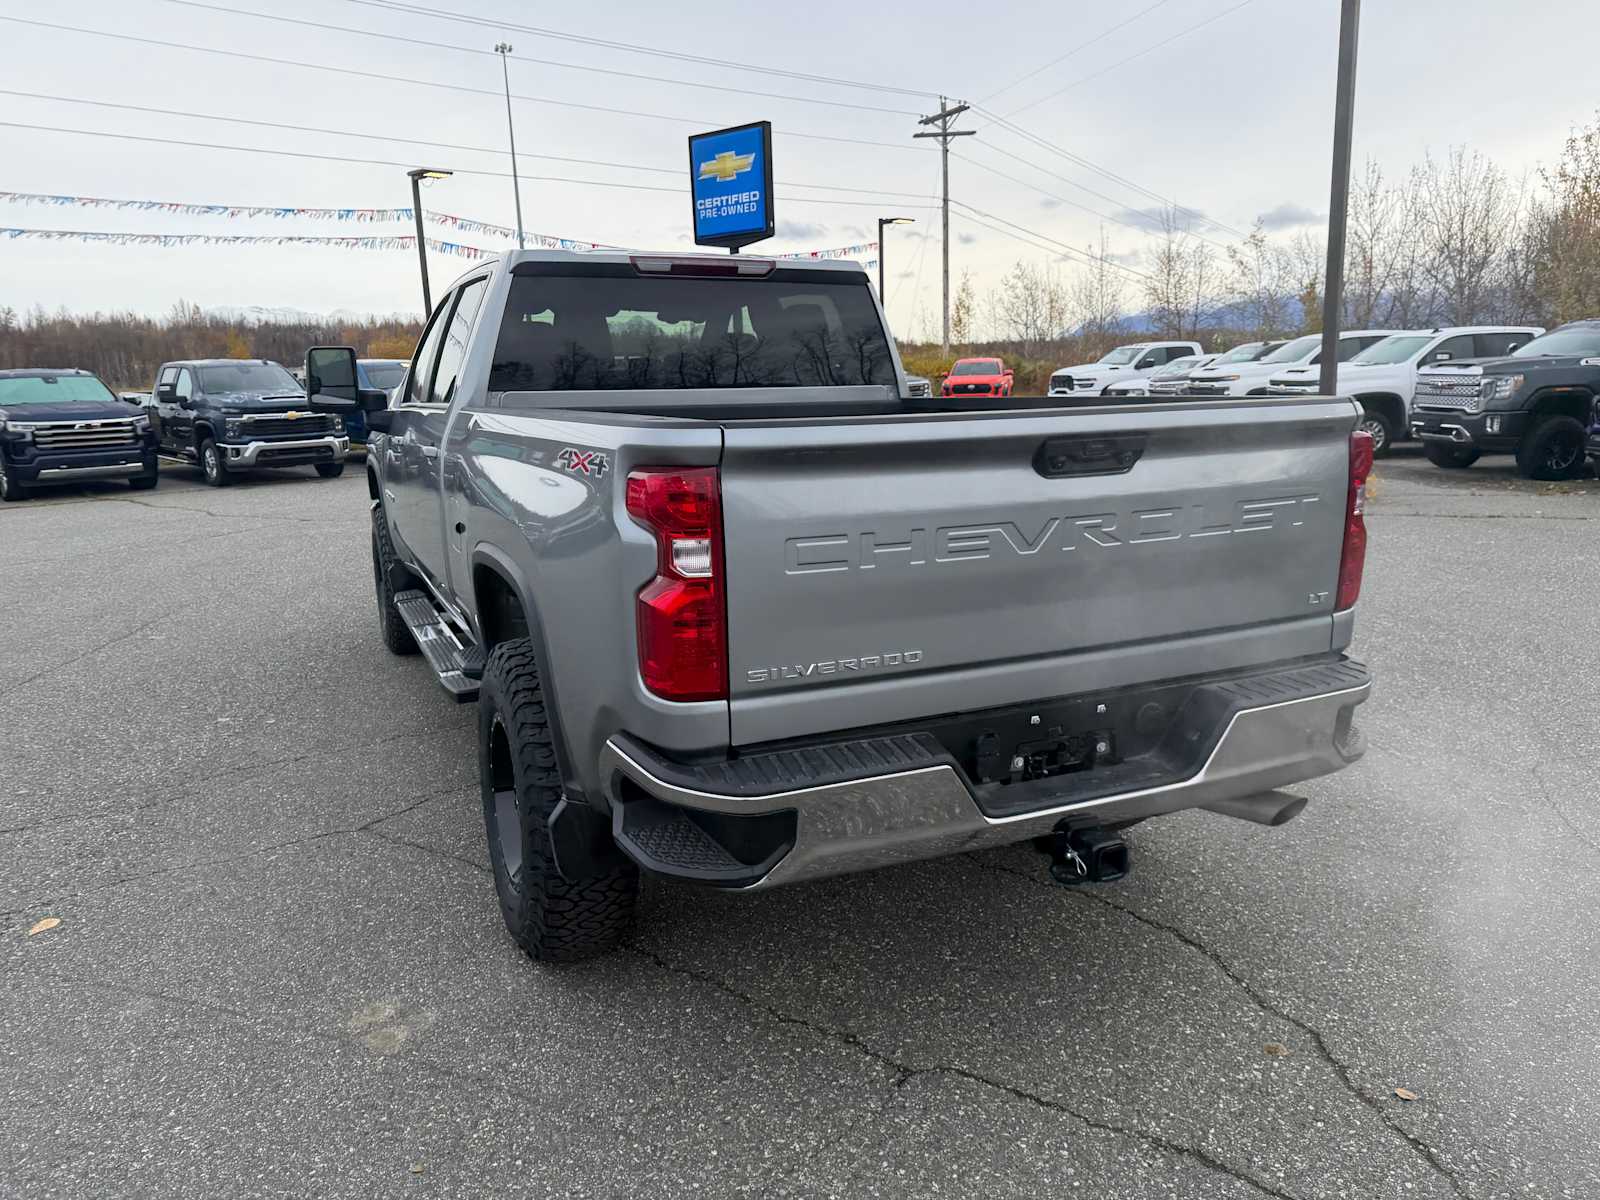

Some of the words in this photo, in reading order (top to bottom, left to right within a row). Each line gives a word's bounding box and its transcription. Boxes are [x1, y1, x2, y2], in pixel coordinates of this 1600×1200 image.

[697, 191, 760, 209] CERTIFIED
[700, 202, 757, 220] PRE-OWNED
[784, 492, 1321, 575] CHEVROLET
[1308, 591, 1329, 605] LT
[747, 650, 923, 683] SILVERADO
